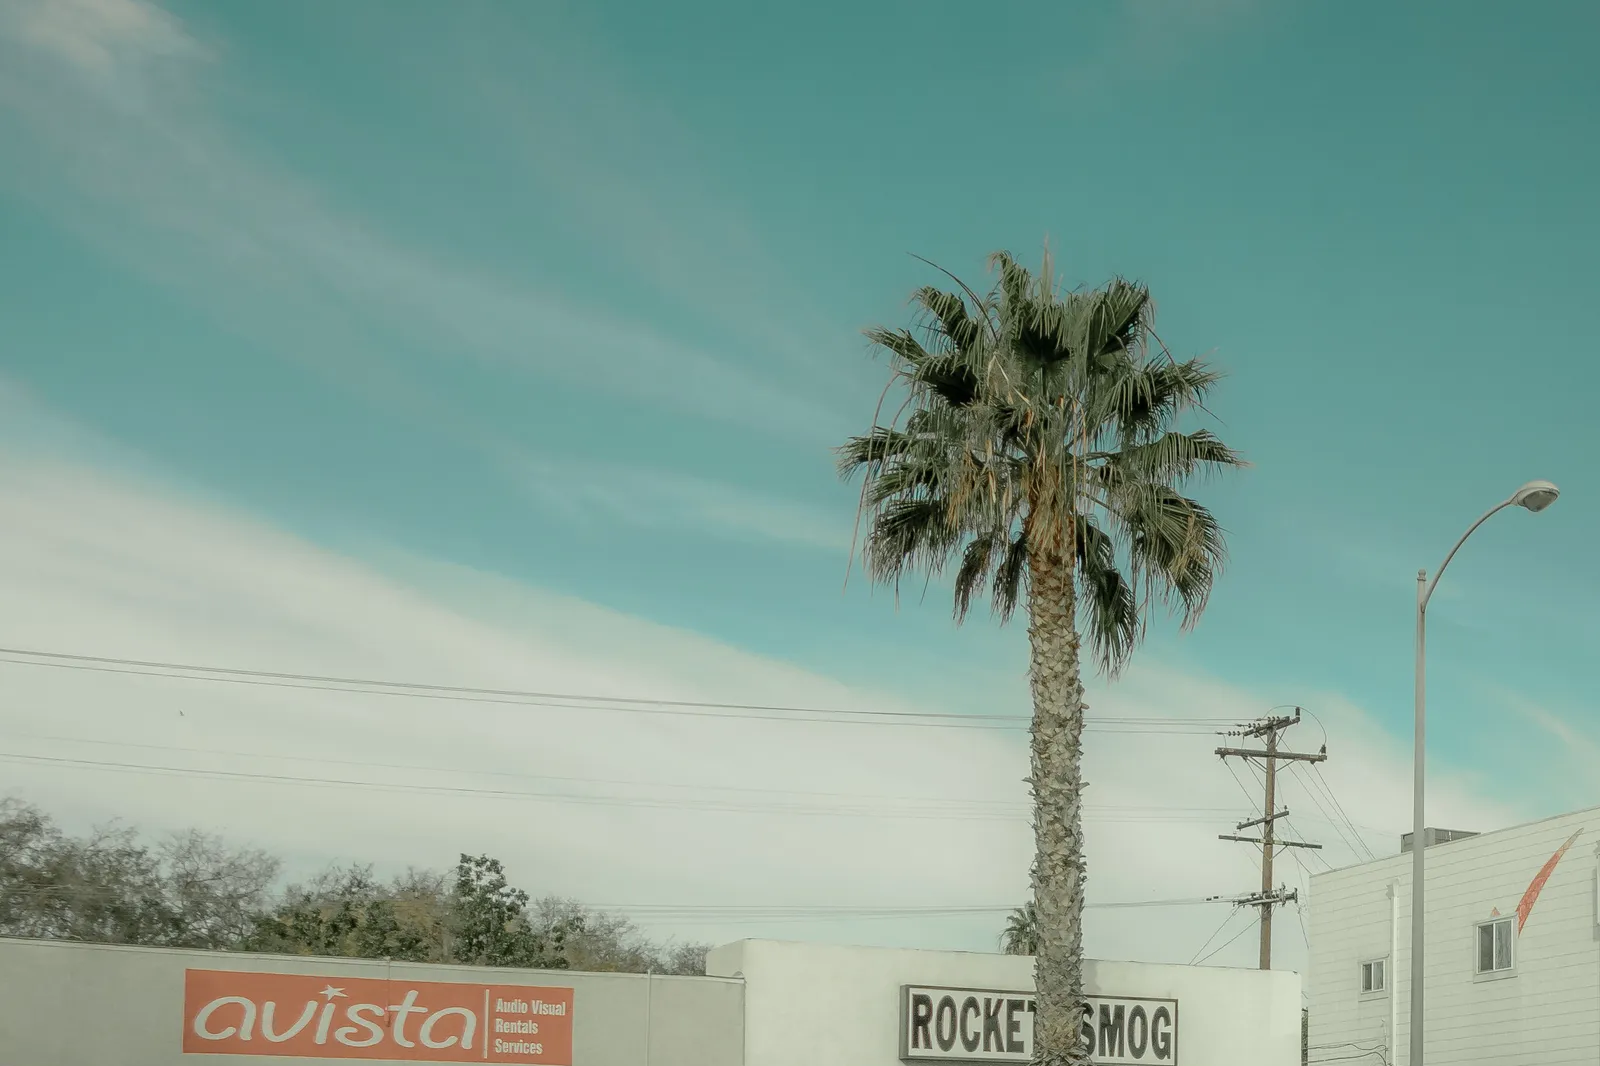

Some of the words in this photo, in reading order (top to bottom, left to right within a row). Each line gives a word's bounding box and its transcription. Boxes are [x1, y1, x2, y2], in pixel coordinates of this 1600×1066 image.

[495, 998, 528, 1014] Audio
[531, 1000, 566, 1016] Visual
[194, 985, 478, 1050] avista
[495, 1018, 539, 1034] Rentals
[911, 993, 1037, 1053] ROCKE
[1080, 1001, 1172, 1060] SMOG
[495, 1038, 543, 1055] Services
